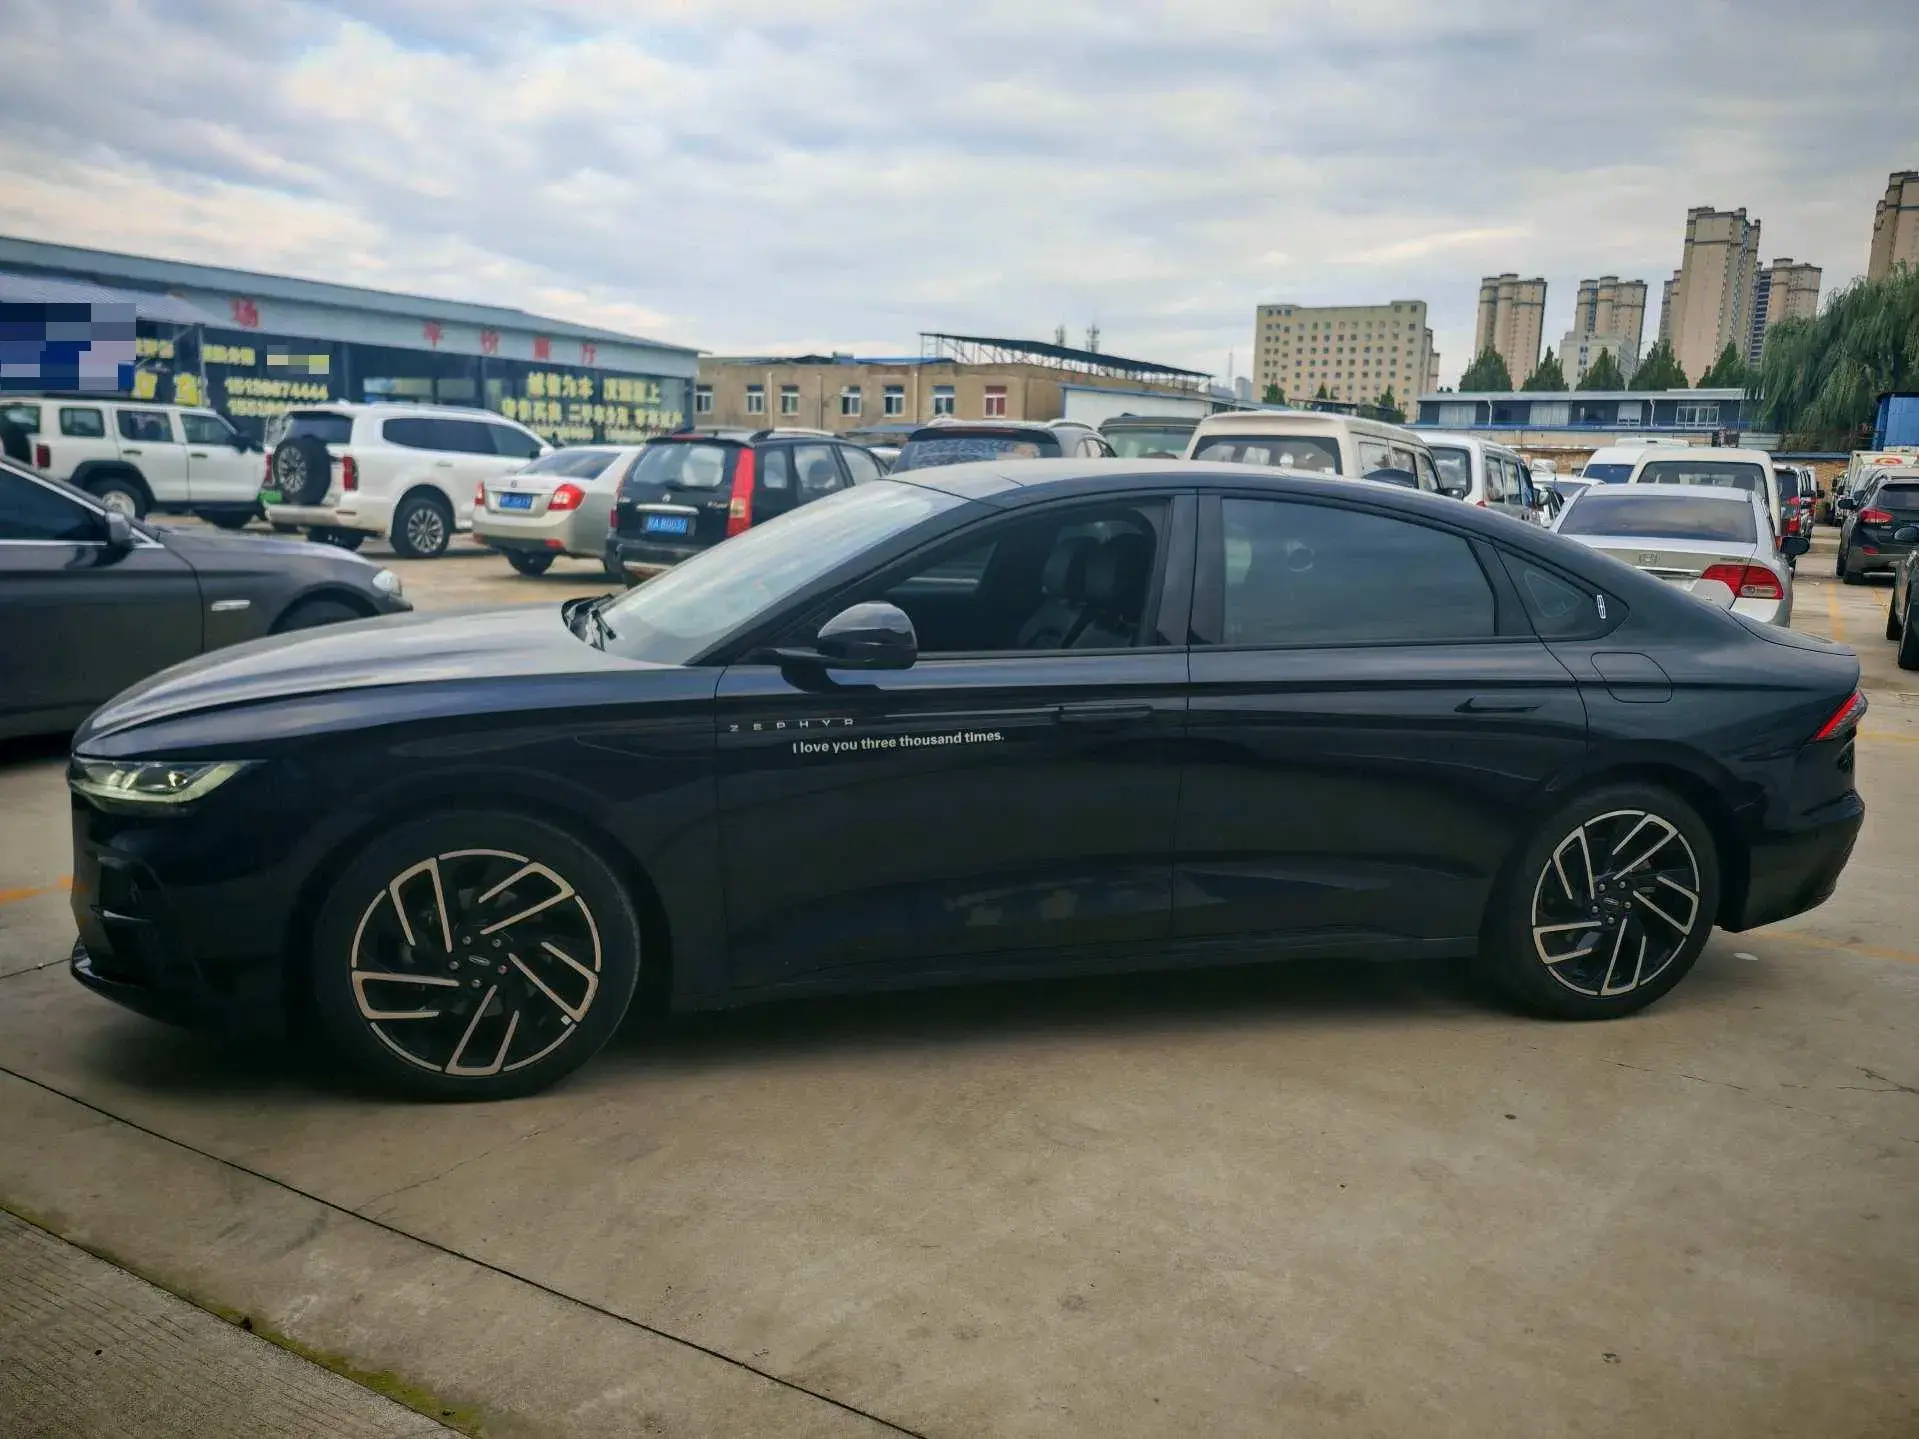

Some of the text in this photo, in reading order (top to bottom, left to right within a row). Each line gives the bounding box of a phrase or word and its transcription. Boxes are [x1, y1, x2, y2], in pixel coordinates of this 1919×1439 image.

[729, 718, 854, 732] ZEPHYR
[792, 730, 1006, 754] I love you three thousand times.
